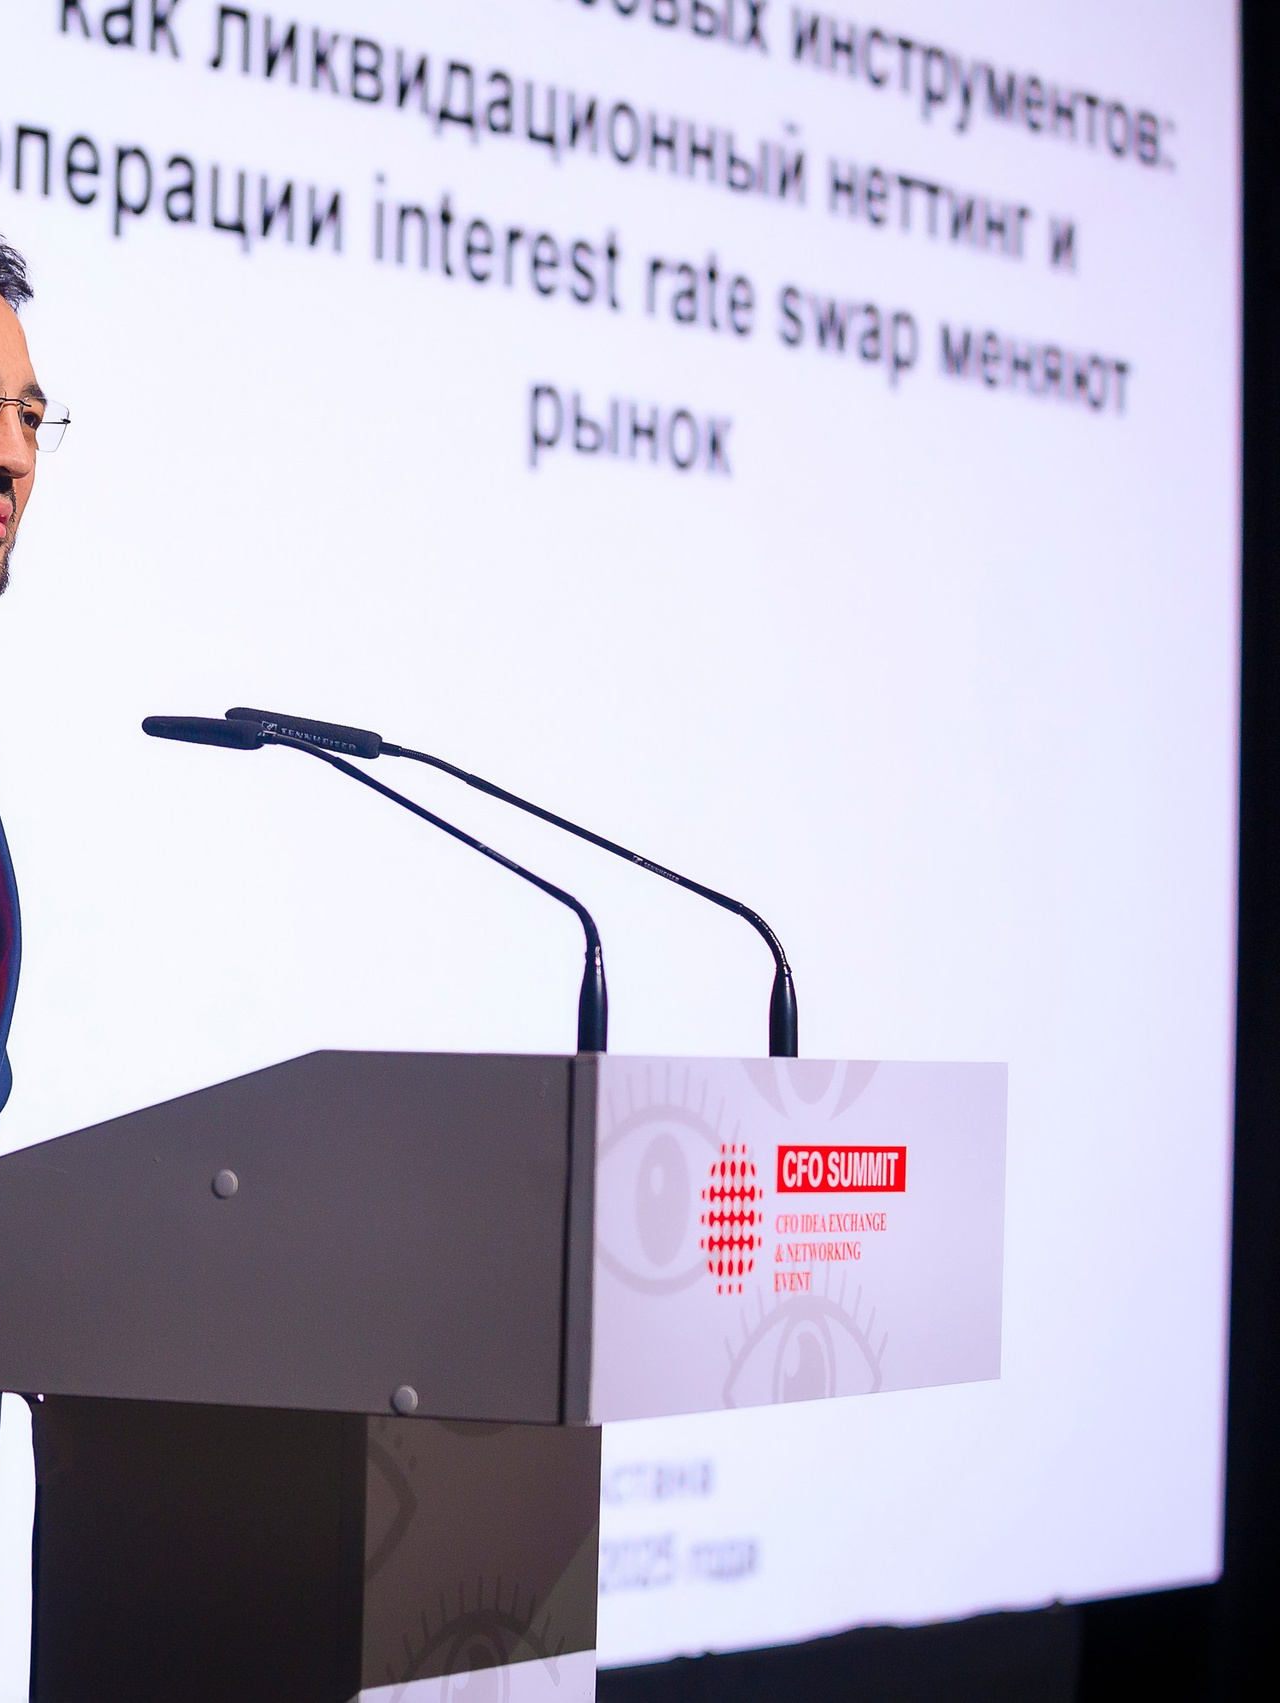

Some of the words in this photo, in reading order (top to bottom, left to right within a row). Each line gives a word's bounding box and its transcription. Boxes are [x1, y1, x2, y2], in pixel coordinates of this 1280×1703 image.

[792, 8, 1173, 169] инструментов:
[59, 0, 181, 58] как
[209, 4, 805, 200] ликвидационный
[829, 160, 1032, 257] неттинг
[1049, 219, 1076, 271] и
[374, 173, 621, 311] interest
[646, 255, 755, 338] rate
[778, 284, 919, 387] swap
[939, 323, 1131, 414] меняют
[528, 383, 732, 474] рынок
[782, 1150, 823, 1188] CFO
[827, 1151, 899, 1187] SUMMIT
[775, 1214, 799, 1234] CFO
[801, 1213, 826, 1233] IDEA
[829, 1212, 887, 1232] EXCHANGE
[775, 1242, 783, 1262] &
[786, 1241, 861, 1262] NETWORKING
[774, 1272, 811, 1292] EVENT
